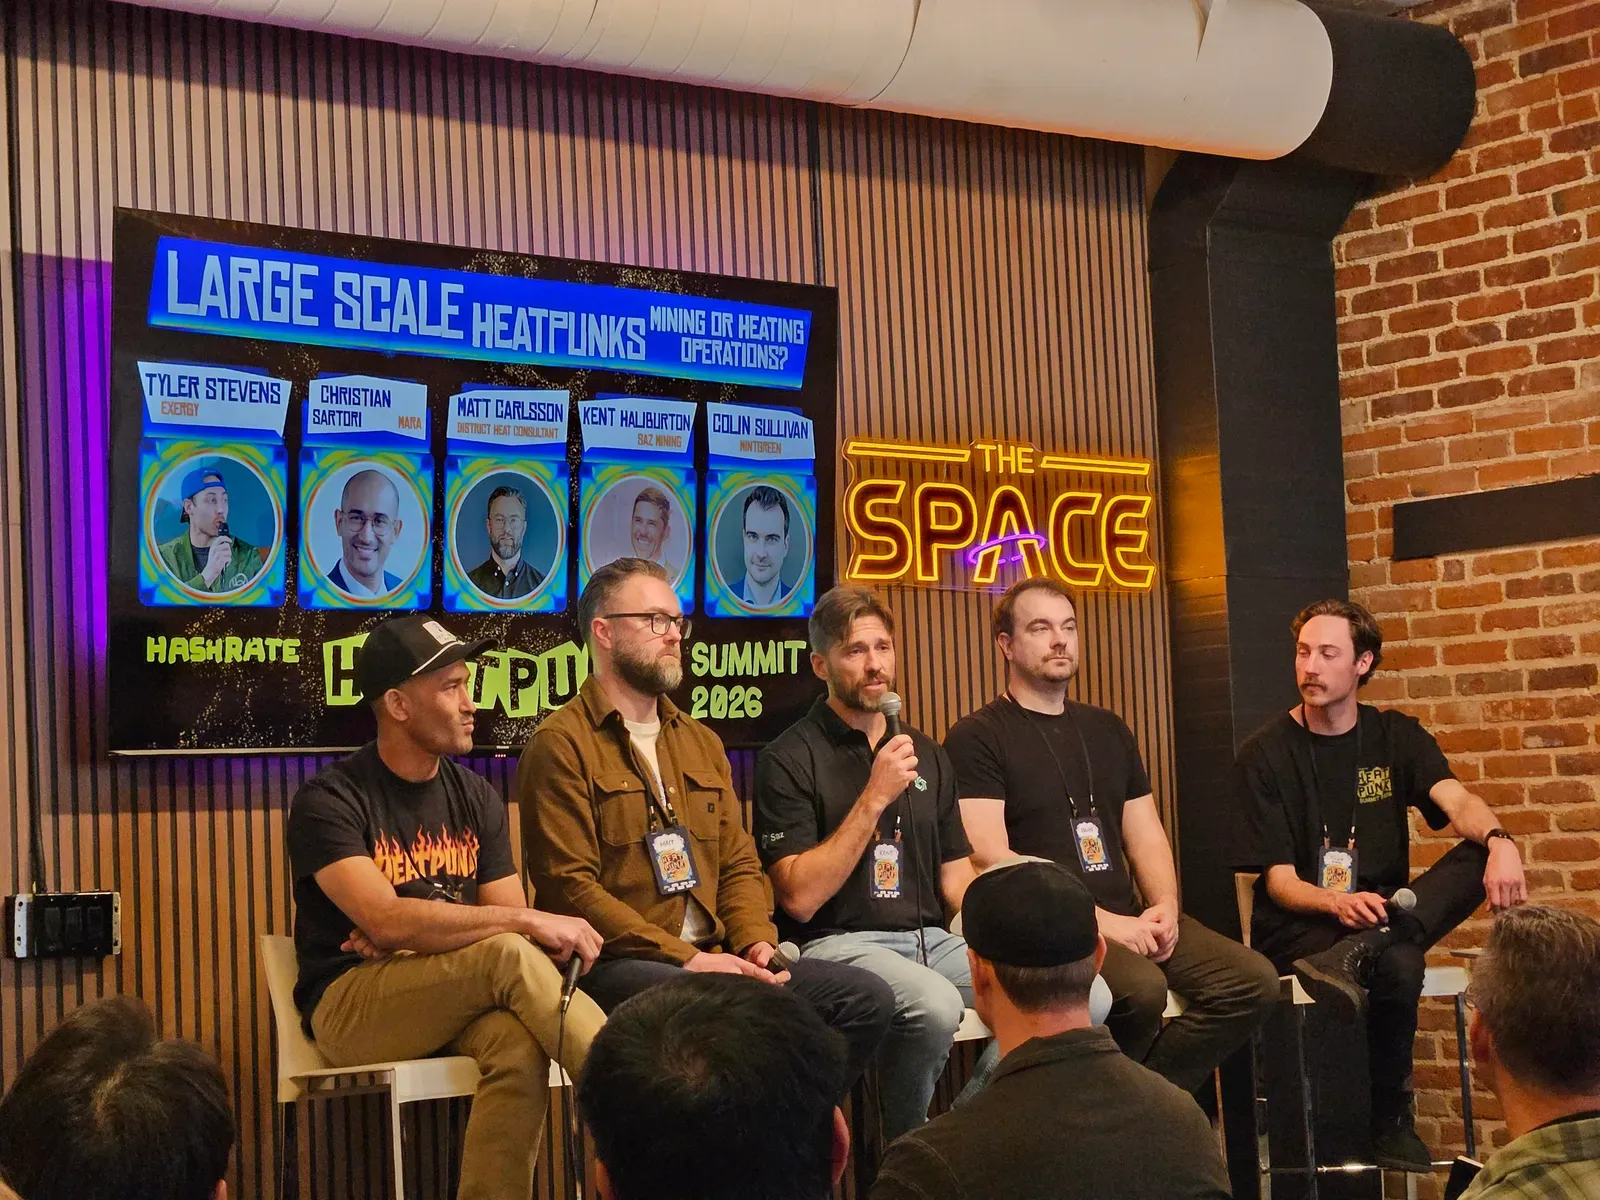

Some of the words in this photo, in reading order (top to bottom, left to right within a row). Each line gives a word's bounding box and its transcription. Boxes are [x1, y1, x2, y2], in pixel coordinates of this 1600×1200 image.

[167, 250, 319, 327] LARGE
[333, 271, 464, 340] SCALE
[472, 302, 646, 361] HEATPUNKS
[650, 305, 706, 336] MINING
[711, 311, 734, 338] OR
[738, 314, 805, 345] HEATING
[681, 336, 789, 371] OPERATIONS?
[145, 373, 199, 399] TYLER
[205, 377, 281, 405] STEVENS
[321, 385, 391, 408] CHRISTIAN
[161, 401, 199, 416] EXERGY
[312, 408, 362, 427] SARTORI
[457, 397, 491, 418] MATT
[495, 399, 563, 423] CARLSSON
[583, 406, 616, 427] KENT
[620, 411, 691, 432] HALIBURTON
[398, 415, 422, 430] MARA
[457, 421, 491, 435] DISTRICT
[494, 423, 512, 437] HEAT
[513, 425, 559, 439] CONSULTANT
[712, 413, 751, 436] COLIN
[754, 418, 809, 440] SULLIVAN
[637, 433, 654, 446] SAZ
[655, 434, 682, 448] MINING
[739, 440, 782, 455] MINTGREEN
[974, 443, 1036, 474] THE
[849, 478, 1156, 588] SPACE
[146, 635, 301, 665] HASHRATE
[691, 640, 807, 677] SUMMIT
[690, 686, 763, 719] 2026
[1357, 780, 1392, 798] PUNK
[770, 831, 785, 842] Saz
